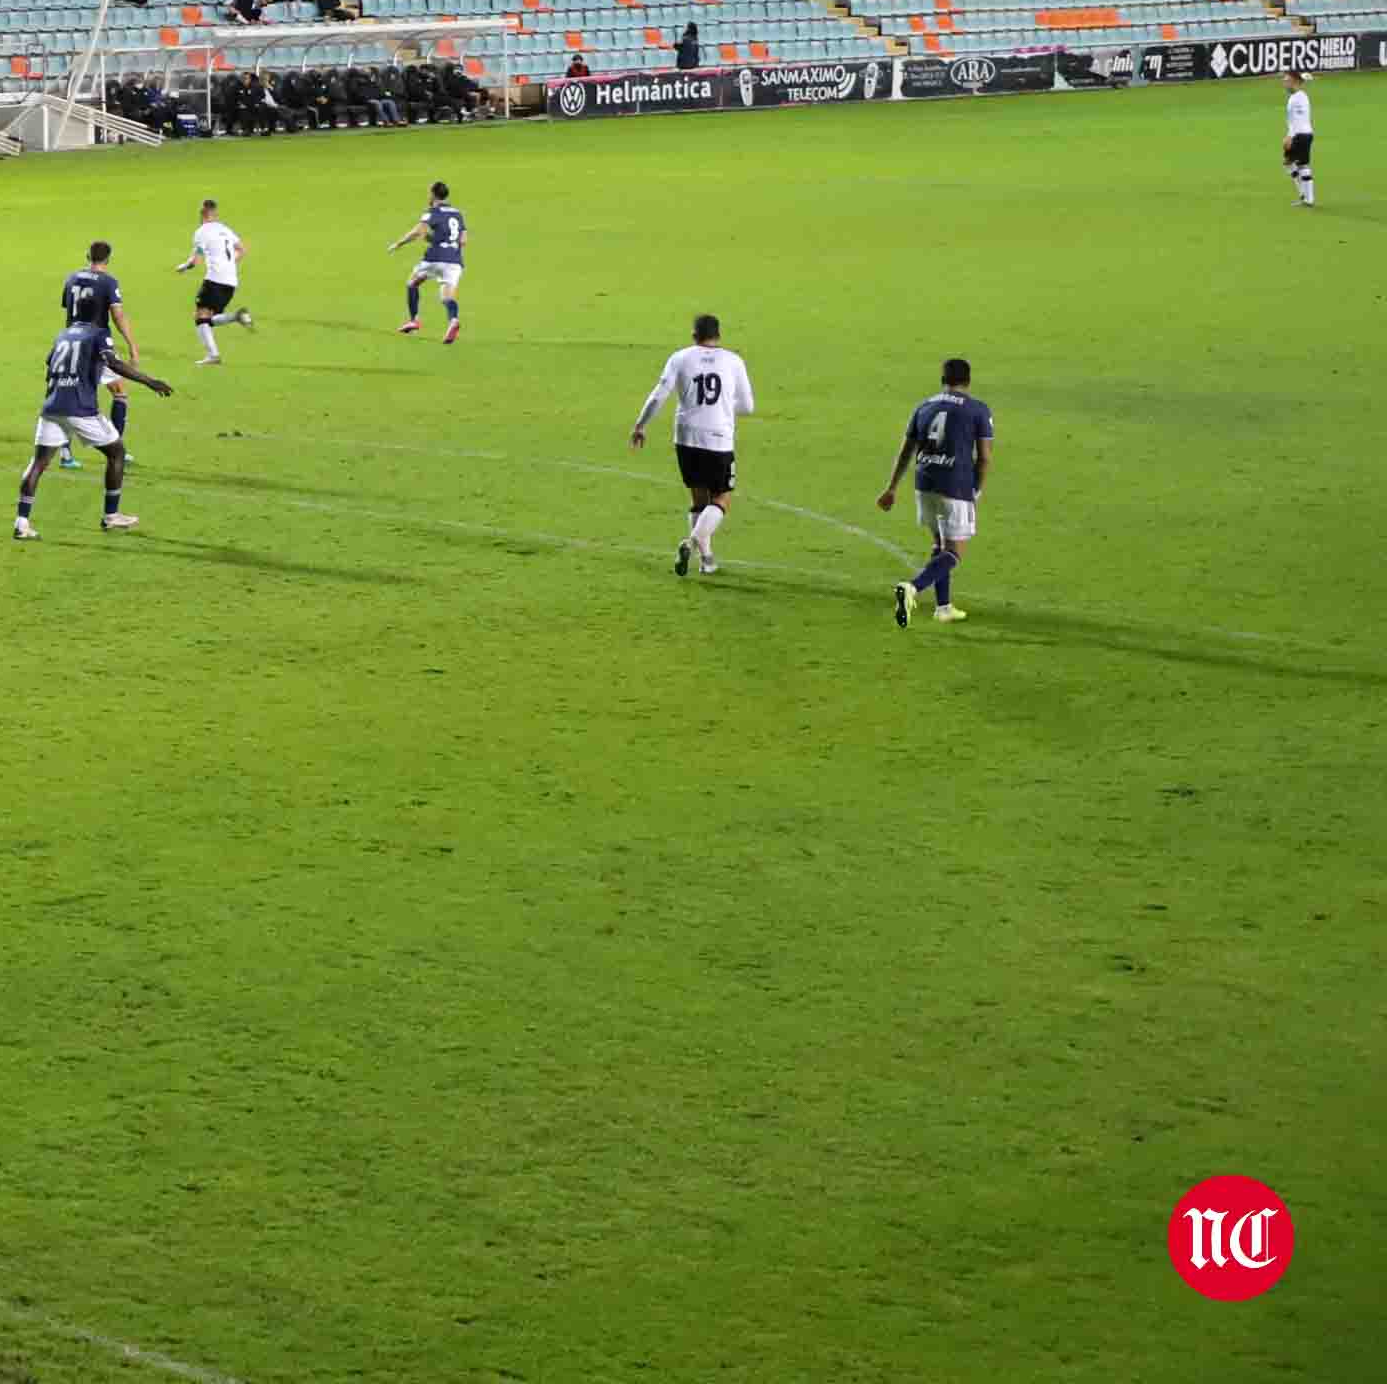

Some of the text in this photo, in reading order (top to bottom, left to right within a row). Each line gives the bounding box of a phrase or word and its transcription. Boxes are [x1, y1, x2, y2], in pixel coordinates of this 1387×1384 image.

[1229, 39, 1319, 73] CUBERS
[1320, 36, 1356, 57] HIELO
[761, 65, 845, 86] SANMAXIMO
[958, 61, 990, 81] ARA
[596, 75, 712, 105] Helmántica
[787, 87, 837, 101] TELECOM
[51, 340, 81, 374] 21
[693, 372, 722, 406] 19
[928, 411, 947, 445] 4
